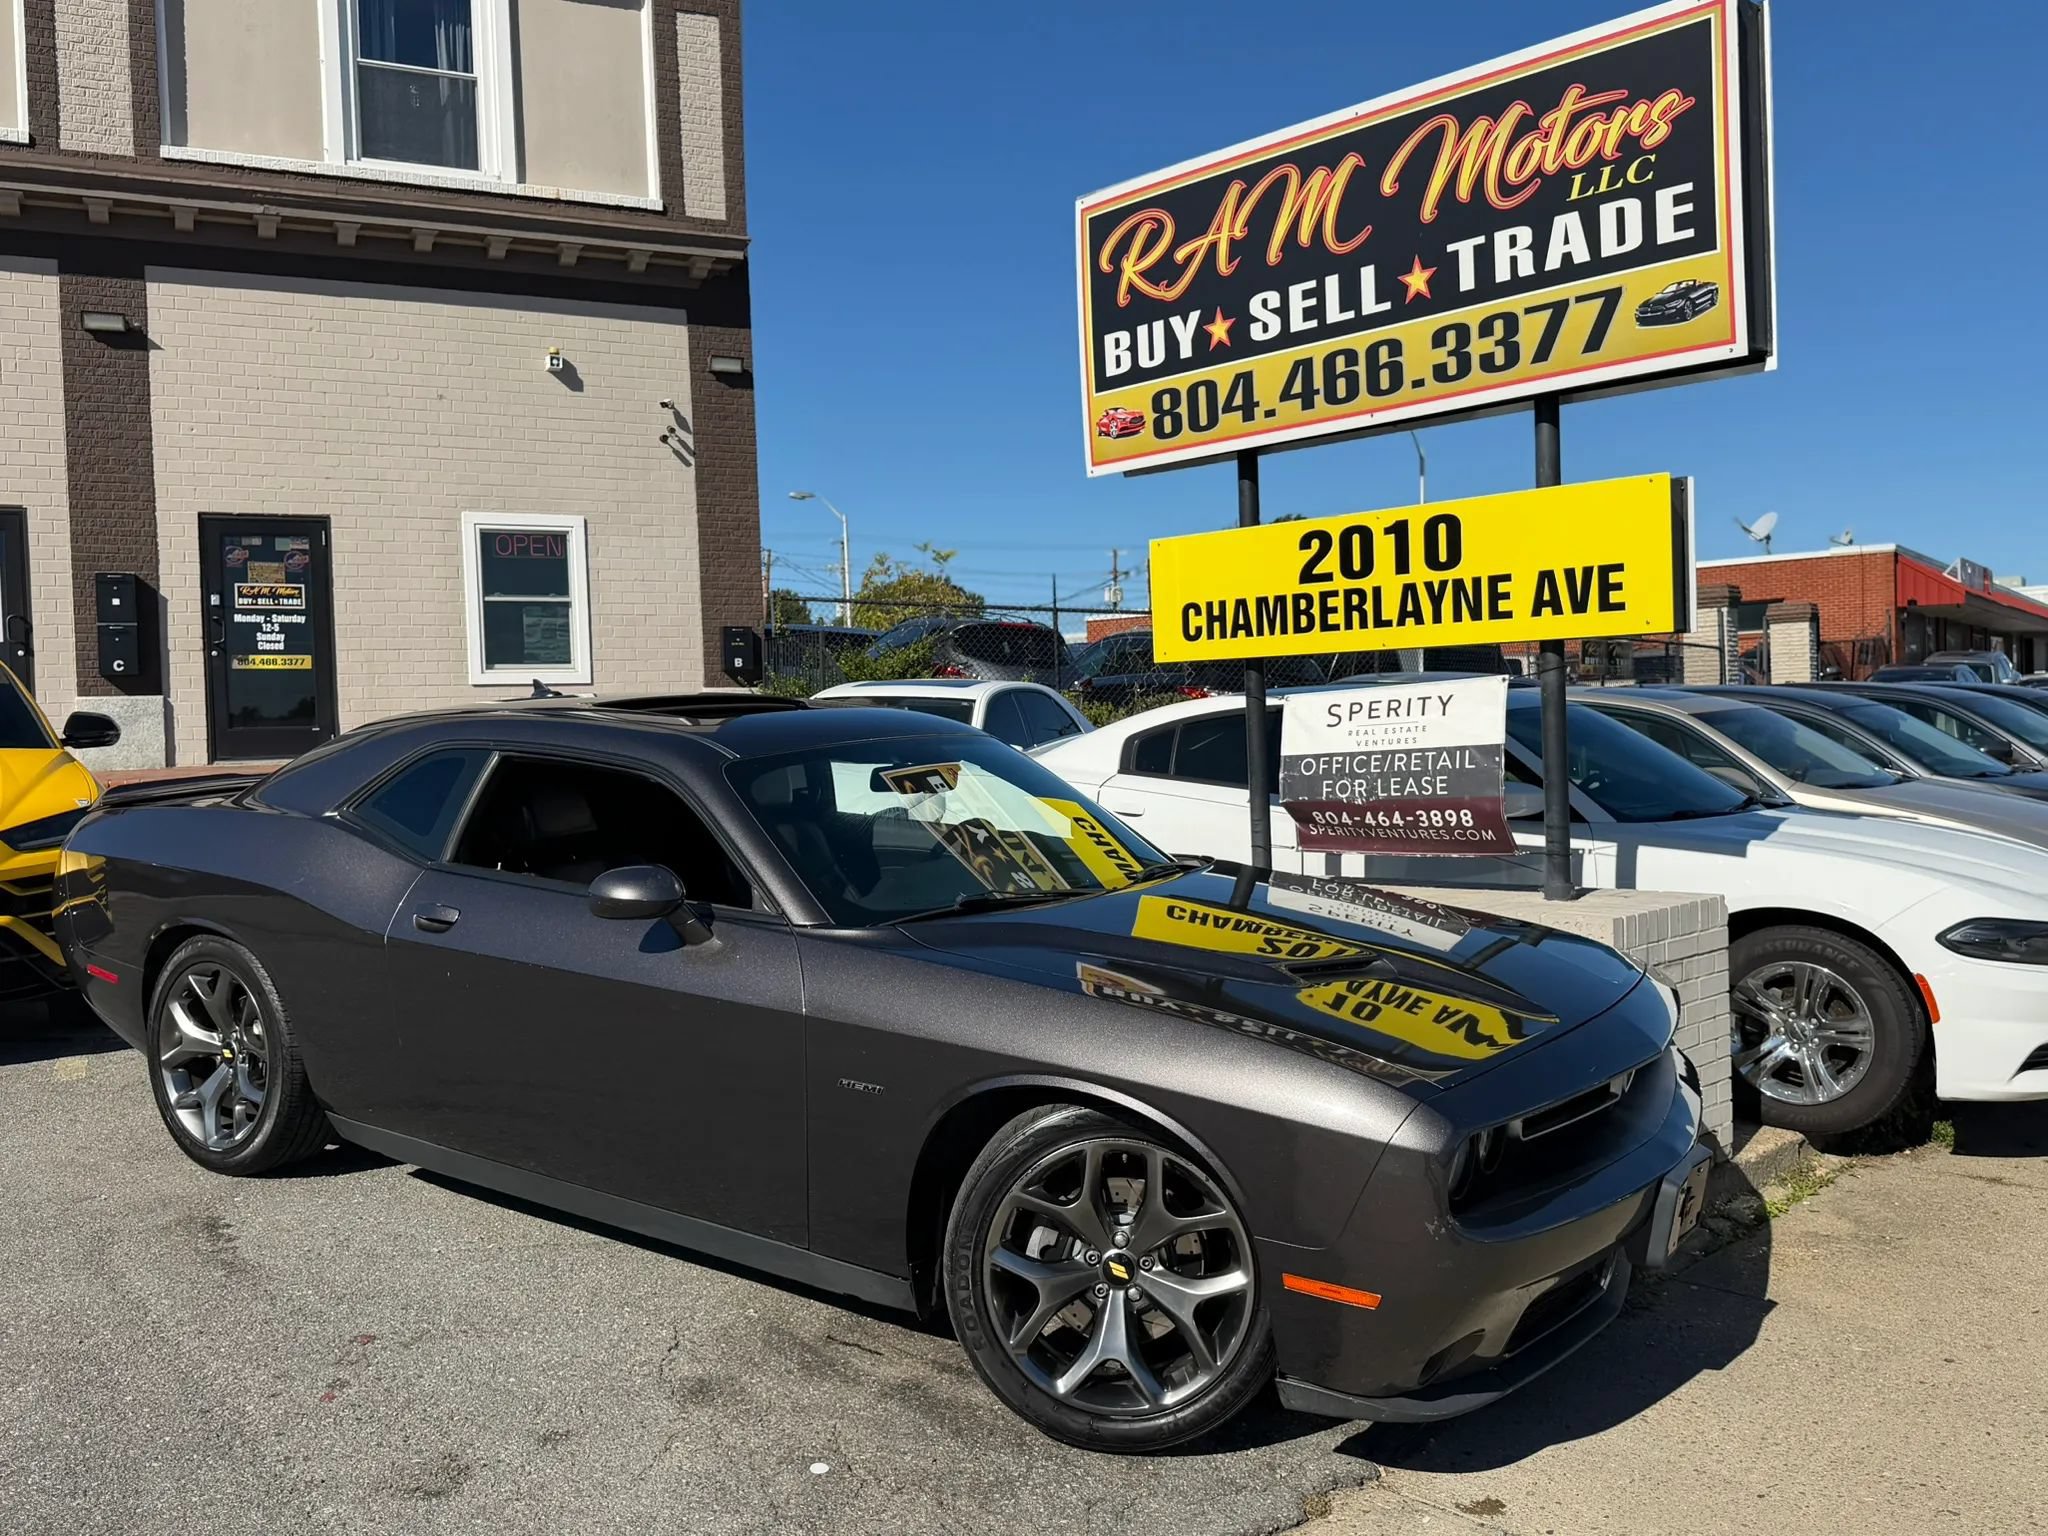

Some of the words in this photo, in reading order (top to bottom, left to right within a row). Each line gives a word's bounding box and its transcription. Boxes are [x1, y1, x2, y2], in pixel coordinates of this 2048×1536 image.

[1566, 154, 1657, 203] LLC
[1100, 152, 1372, 307] RAM
[1381, 84, 1695, 225] Motors
[1104, 309, 1203, 378] BUY
[1249, 264, 1391, 343] SELL
[1446, 182, 1695, 292] TRADE
[1151, 287, 1627, 442] 804.466.3377
[495, 534, 562, 556] OPEN
[1299, 513, 1462, 585] 2010
[1181, 573, 1514, 642] CHAMBERLAYNE
[1531, 563, 1627, 617] AVE
[234, 613, 265, 624] Monday
[272, 614, 306, 624] Saturday
[262, 623, 280, 632] 12-5
[256, 631, 285, 642] Sunday
[257, 641, 285, 650] Closed
[113, 660, 125, 672] C
[734, 657, 743, 668] B
[1326, 693, 1455, 728] SPERITY
[1347, 728, 1377, 737] REAL
[1384, 724, 1428, 735] ESTATE
[1355, 736, 1418, 748] VENTURES
[1300, 750, 1476, 776] OFFICE/RETAIL
[1322, 779, 1368, 799] FOR
[1378, 776, 1449, 797] LEASE
[1311, 808, 1475, 828] 804-464-3898
[1309, 823, 1497, 842] SPERITYVENTURES.COM
